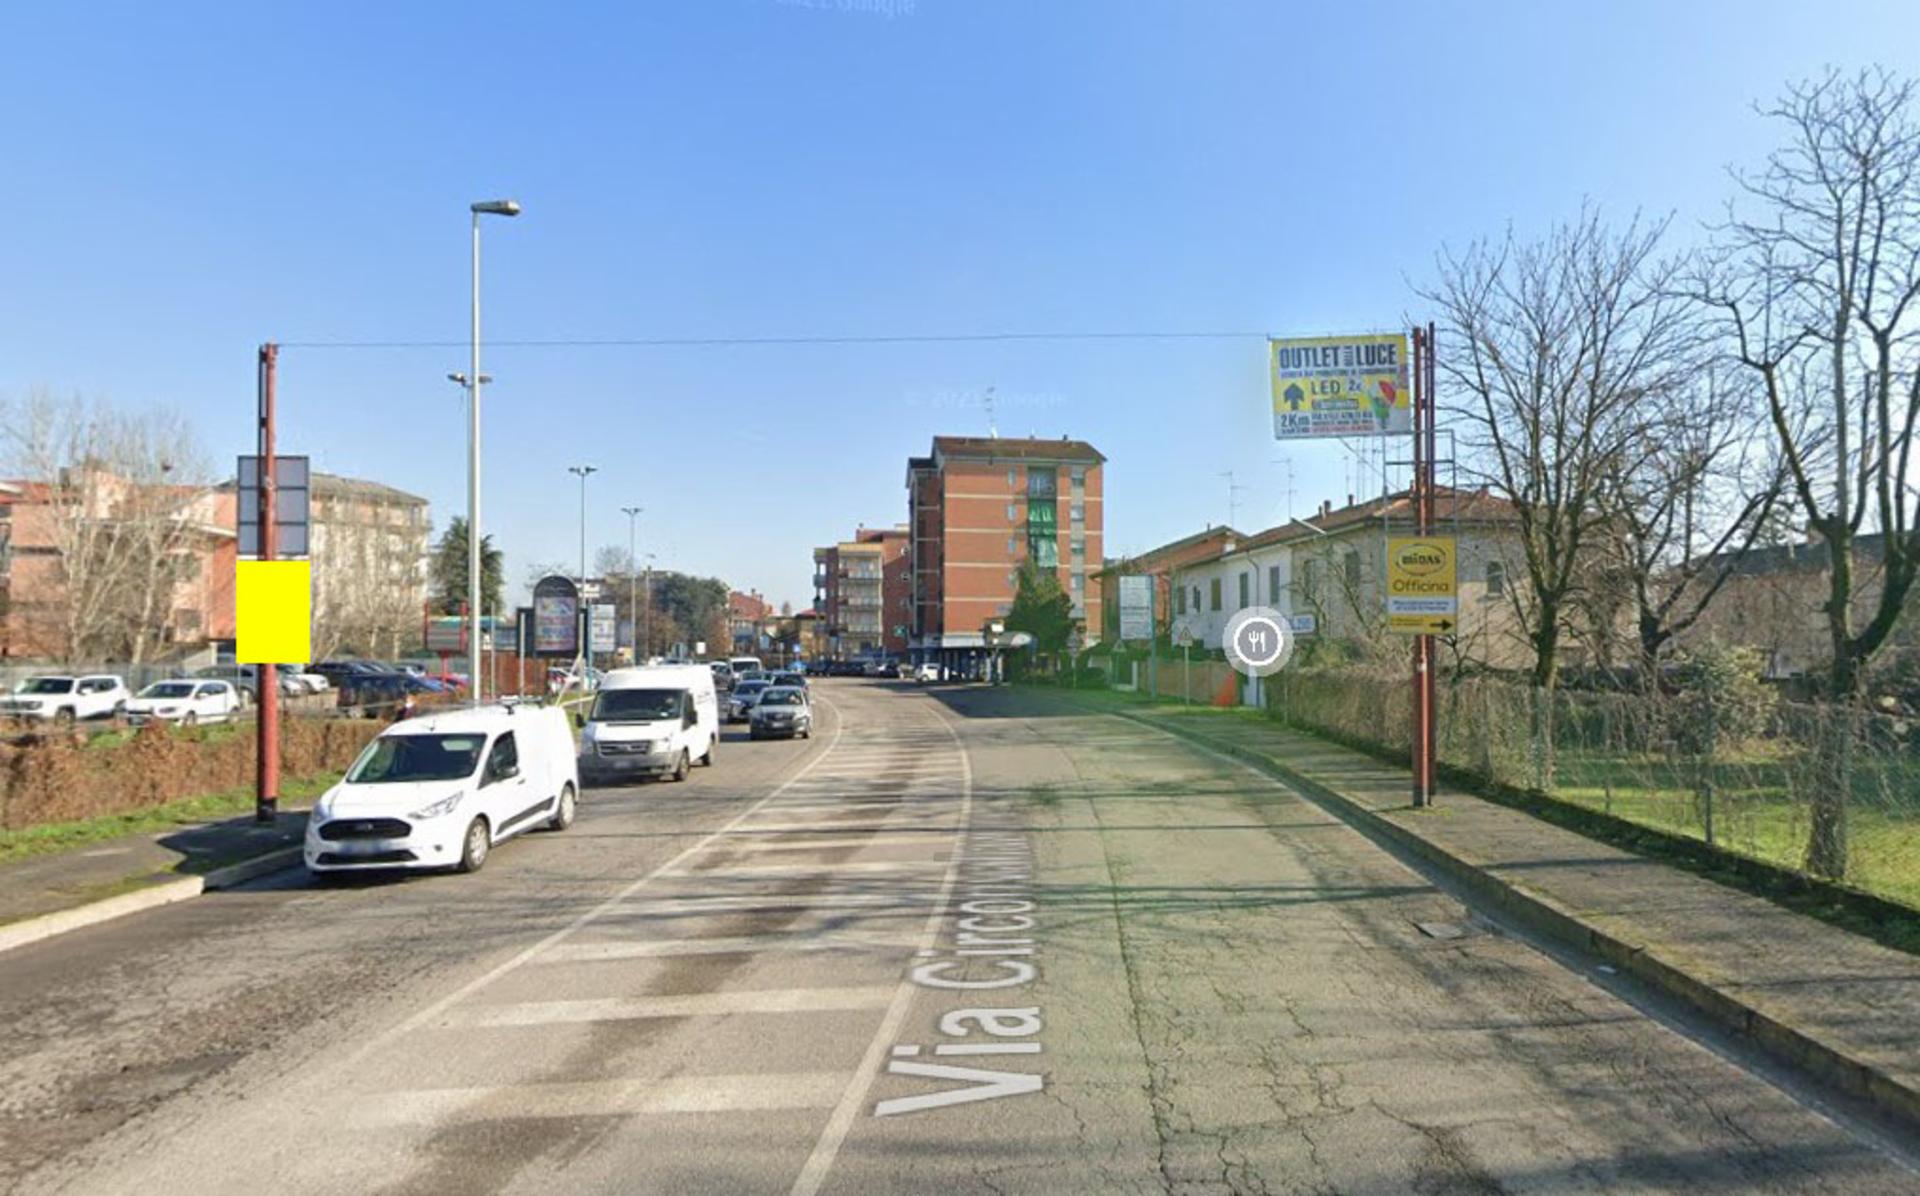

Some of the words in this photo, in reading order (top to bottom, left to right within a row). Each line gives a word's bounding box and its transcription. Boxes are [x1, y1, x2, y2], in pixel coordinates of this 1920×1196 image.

[1279, 346, 1340, 369] OUTLET
[1356, 344, 1397, 366] LUCE
[1311, 380, 1341, 395] LED
[1281, 414, 1310, 428] 2Km
[1392, 578, 1449, 593] Officina
